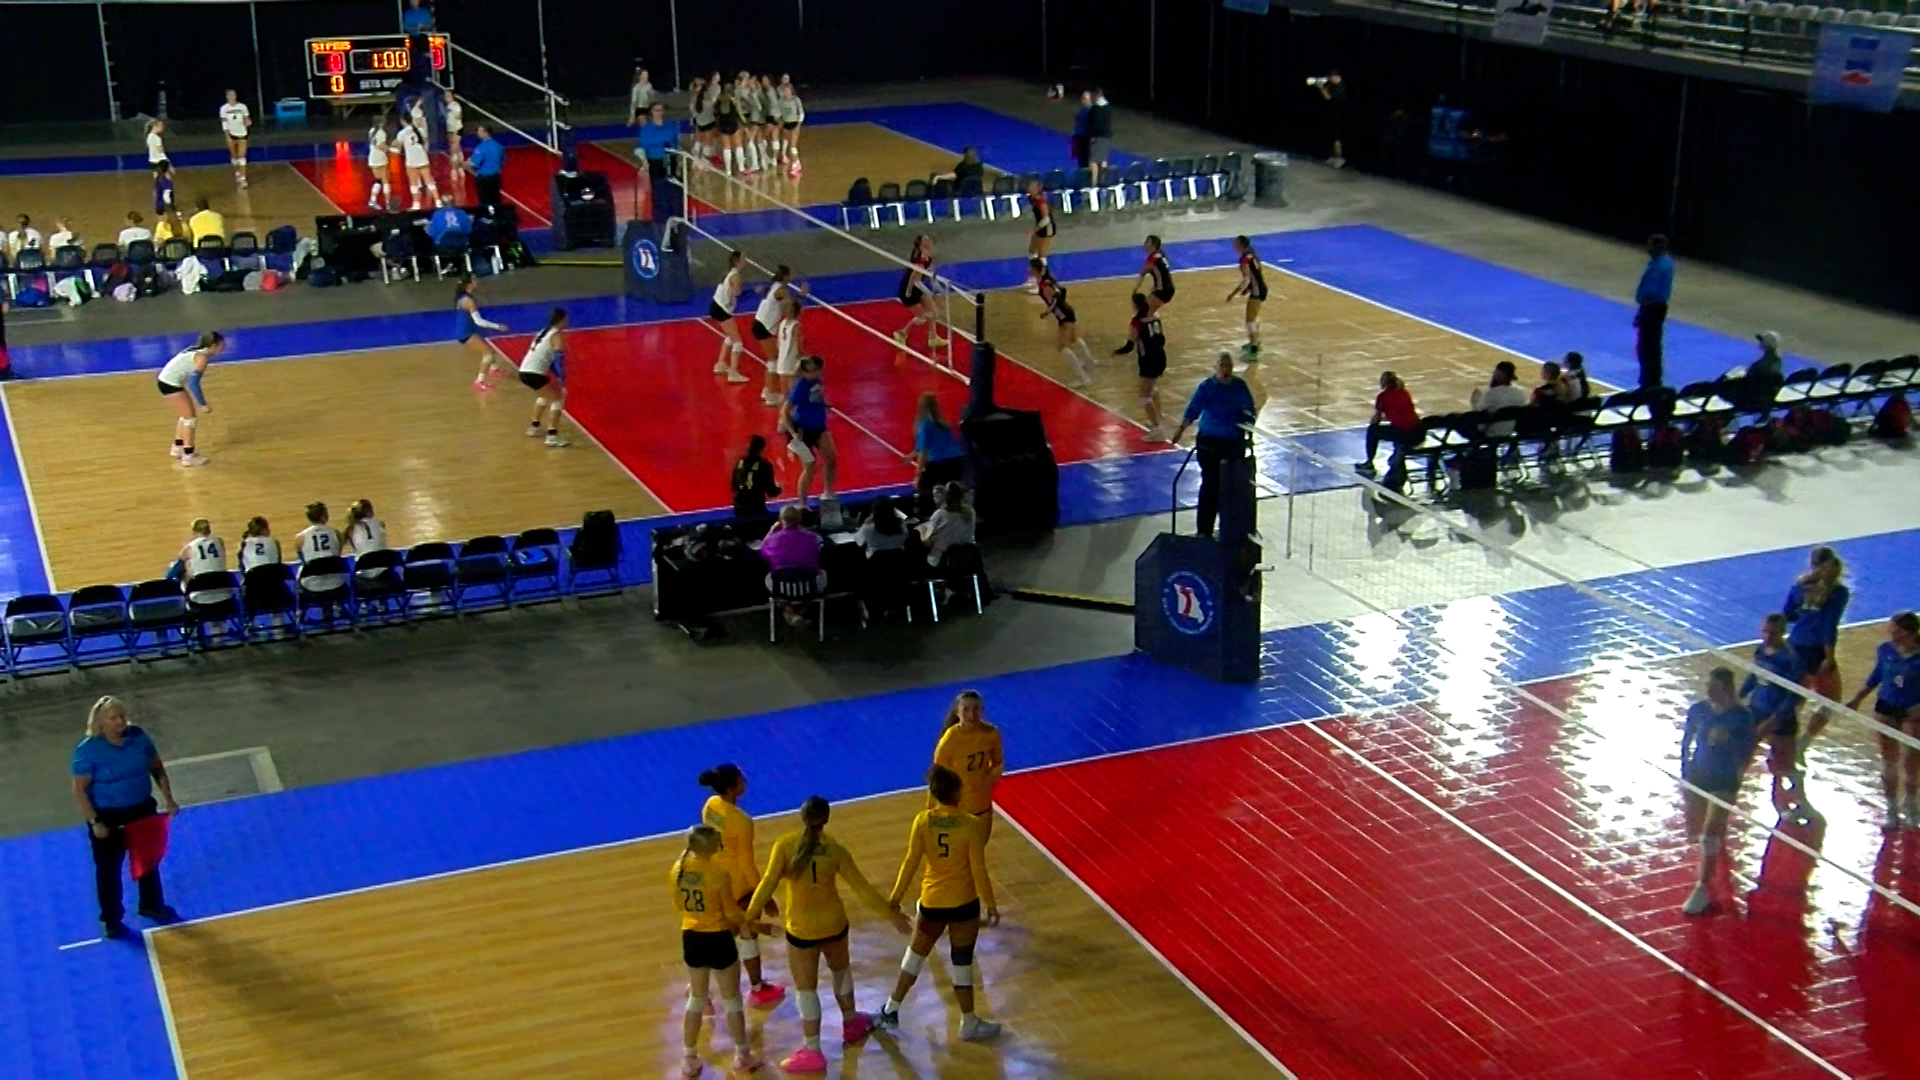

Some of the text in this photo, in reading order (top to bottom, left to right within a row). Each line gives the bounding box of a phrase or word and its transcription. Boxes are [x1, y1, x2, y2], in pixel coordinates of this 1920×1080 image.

[330, 75, 344, 92] 0
[364, 524, 373, 540] 1
[197, 542, 220, 560] 14
[255, 543, 266, 556] 2
[312, 534, 331, 552] 12
[967, 751, 985, 772] 27
[938, 833, 949, 858] 5
[811, 861, 817, 884] 1
[680, 887, 705, 912] 28
